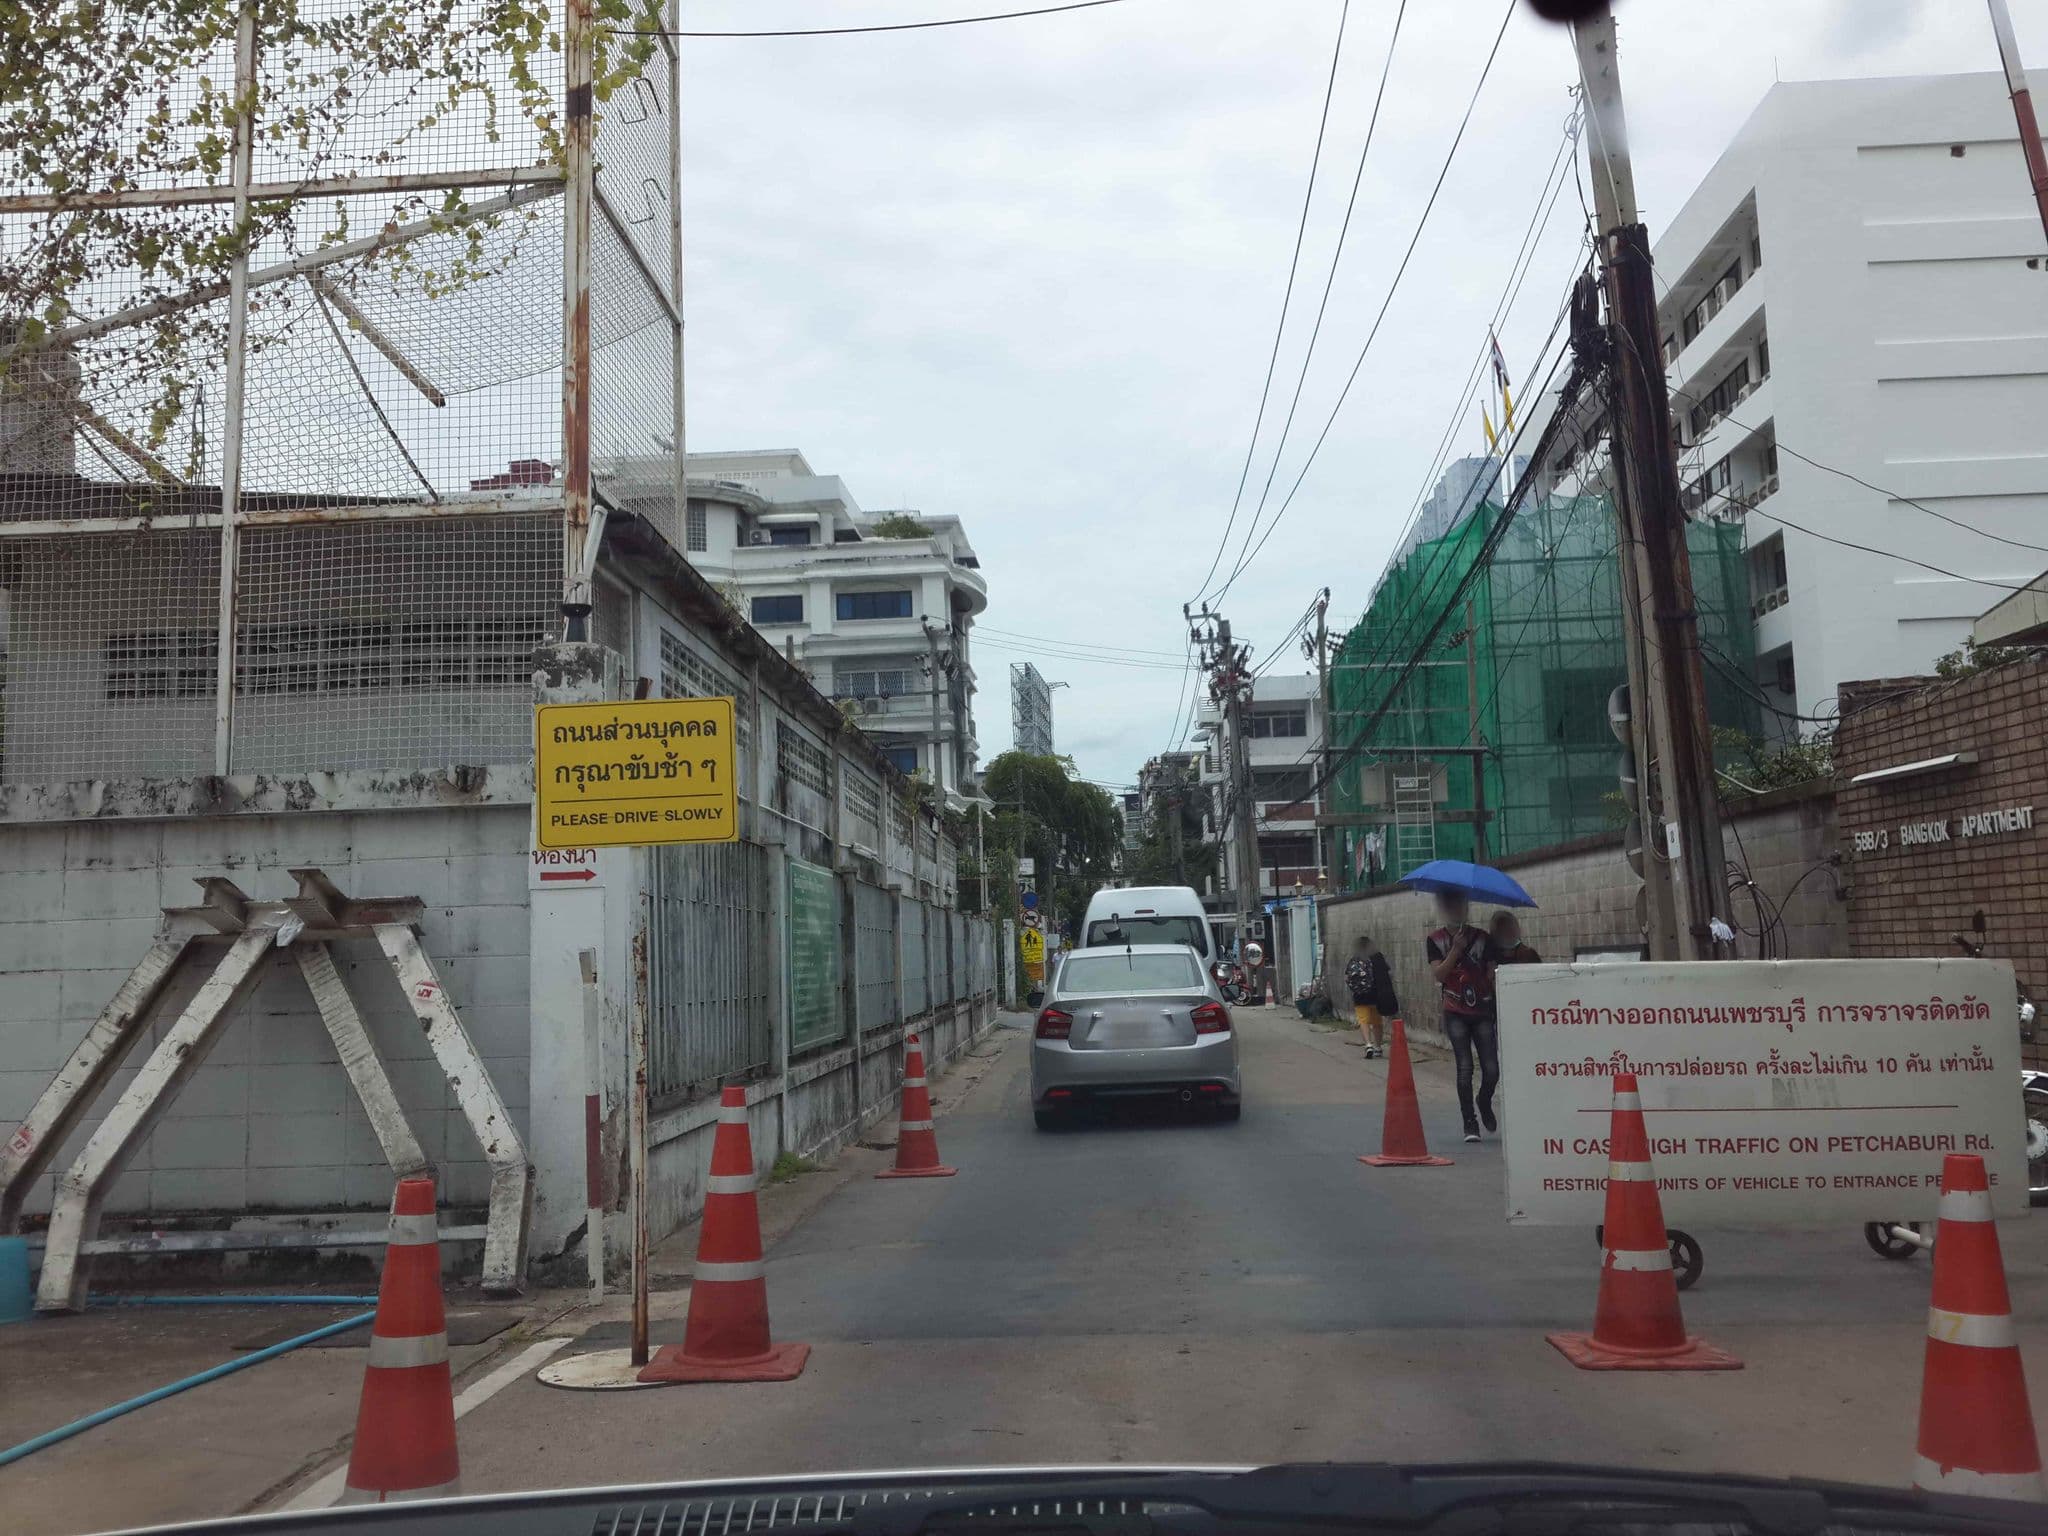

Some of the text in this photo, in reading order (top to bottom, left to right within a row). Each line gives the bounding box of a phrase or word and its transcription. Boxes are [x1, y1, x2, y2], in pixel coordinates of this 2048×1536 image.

[552, 716, 718, 748] ถนนส่วนบุคคล
[554, 752, 718, 793] กรุณาขับช้า ๆ
[551, 807, 724, 827] PLEASE DRIVE SLOWLY
[1900, 819, 1951, 846] BANGKOK
[1961, 806, 2034, 838] APARTMENT
[1531, 995, 1991, 1033] กรณีทางออกถนนเพชรบุรี การจราจรติดขัด
[1535, 1045, 1994, 1077] สงวนสิทธิ์ในการปล่อยรถ ครั้งละไม่เกิน 10 คัน เท่านั้น
[1543, 1138, 1564, 1155] IN
[1573, 1138, 1611, 1155] CAS
[1695, 1137, 1780, 1155] TRAFFIC
[1788, 1136, 1819, 1153] ON
[1828, 1134, 1956, 1153] PETCHABURI
[1964, 1134, 1995, 1151] Rd.
[1543, 1178, 1609, 1192] RESTRIC
[1704, 1177, 1727, 1191] OF
[1732, 1176, 1799, 1190] VEHICLE
[1805, 1176, 1827, 1189] TO
[1834, 1174, 1919, 1189] ENTRANCE
[1924, 1174, 1943, 1188] PE
